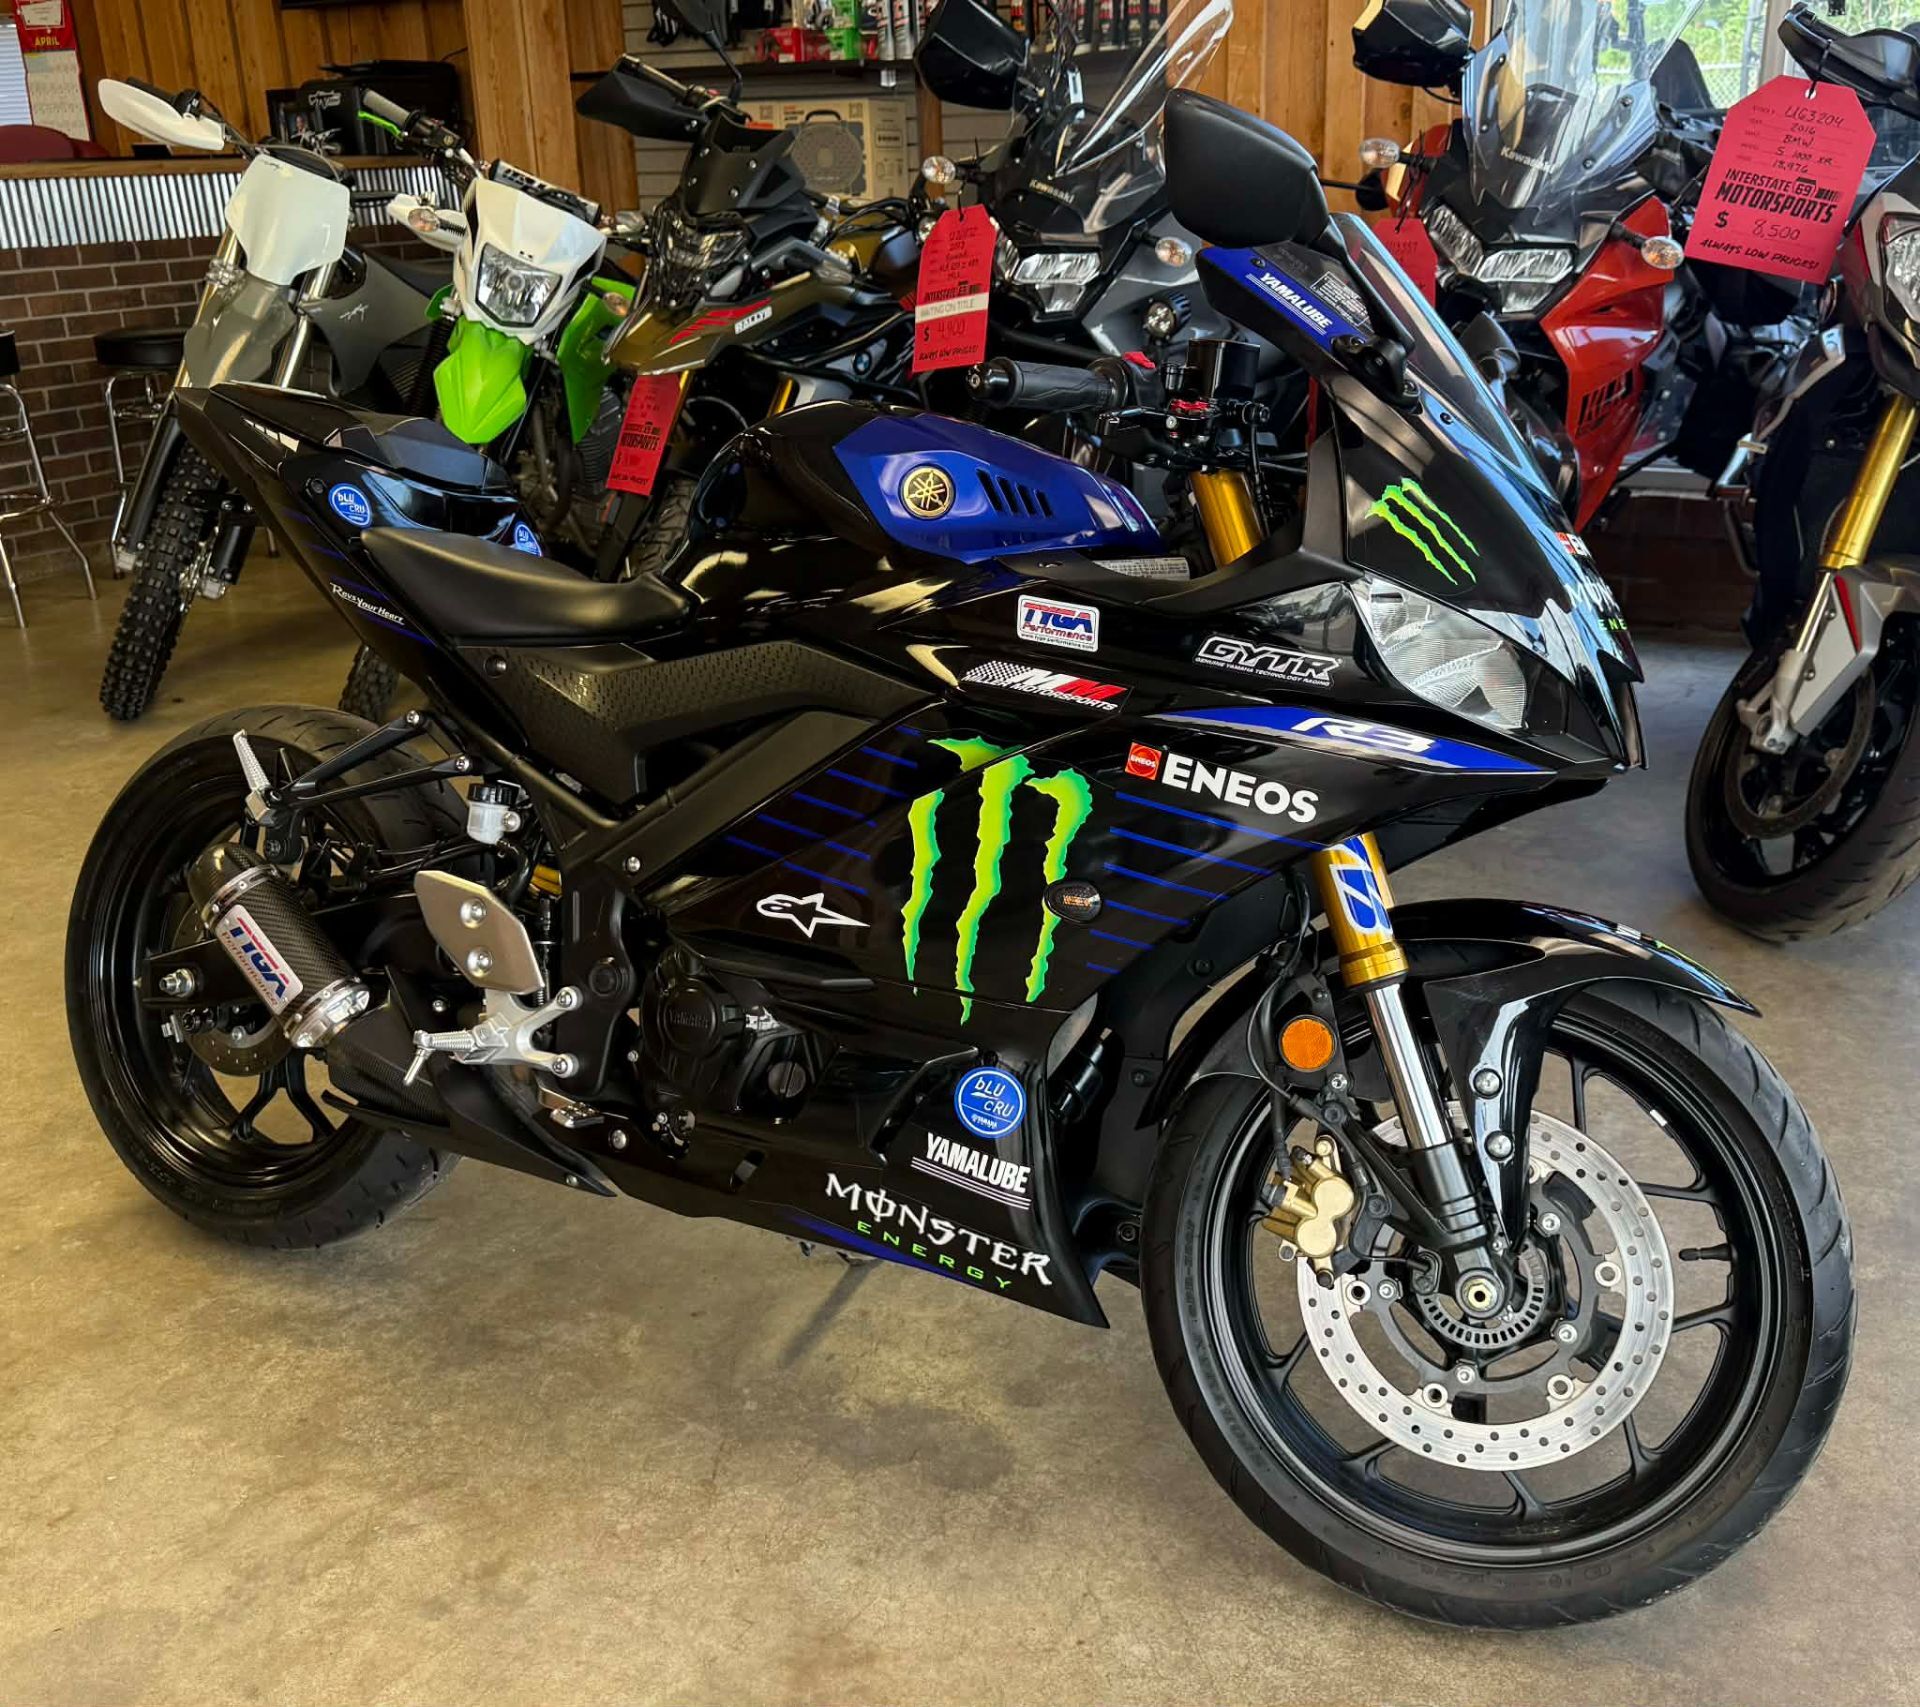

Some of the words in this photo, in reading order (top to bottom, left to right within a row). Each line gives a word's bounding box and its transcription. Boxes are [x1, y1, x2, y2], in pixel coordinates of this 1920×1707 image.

[34, 36, 60, 46] APRIL
[1783, 134, 1814, 148] BMW
[1029, 178, 1075, 204] Kawasaki
[1725, 168, 1792, 193] INTERSTATE
[1795, 184, 1813, 198] 69
[1715, 181, 1838, 224] MOTORSPORTS
[1715, 209, 1729, 228] $
[1752, 219, 1801, 241] 8,500
[1700, 239, 1743, 255] ALWAYS
[1744, 247, 1770, 260] LOW
[1771, 252, 1820, 270] PRICES!
[1260, 272, 1334, 329] YAMALUBE
[329, 581, 357, 603] Revs
[357, 597, 379, 611] Your
[1022, 621, 1093, 641] Performance
[1024, 602, 1093, 633] TYGA
[1198, 636, 1340, 681] GYTR
[1226, 662, 1254, 674] YAMAHA
[1255, 668, 1303, 682] TECHNOLOGY
[1302, 677, 1330, 687] RACING
[961, 675, 1009, 687] MILLER
[1010, 683, 1119, 711] MOTORSPORTS
[1291, 717, 1437, 753] R3
[1162, 752, 1319, 823] ENEOS
[229, 917, 290, 999] TYGA
[975, 1076, 1006, 1097] bLU
[984, 1100, 1014, 1117] cRU
[926, 1132, 1031, 1194] YAMALUBE
[825, 1172, 1053, 1286] MONSTER
[857, 1220, 1013, 1289] ENERGY
